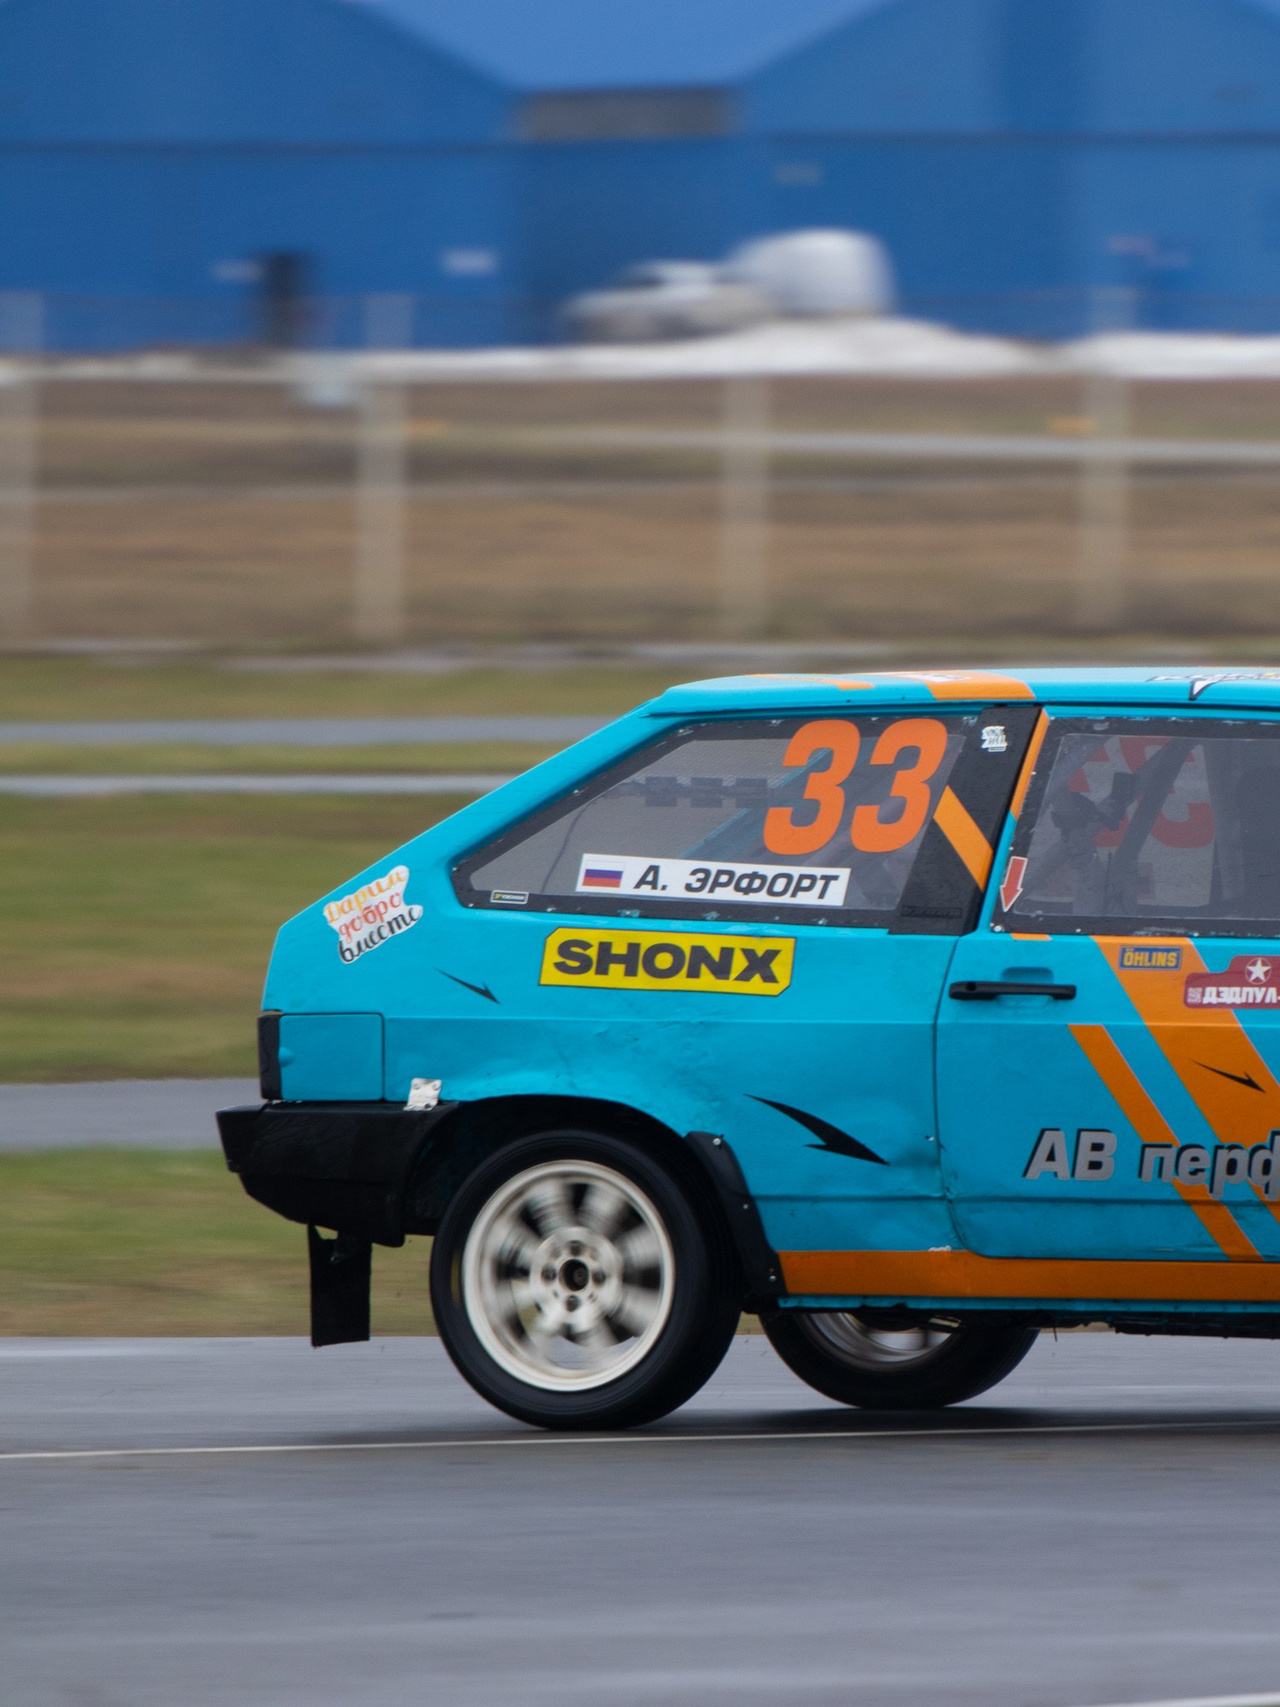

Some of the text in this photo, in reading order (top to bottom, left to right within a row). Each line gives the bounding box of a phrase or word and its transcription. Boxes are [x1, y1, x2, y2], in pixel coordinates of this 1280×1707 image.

[763, 718, 948, 855] 33
[634, 865, 840, 900] А. ЭРФОРТ
[553, 938, 782, 984] SHONX
[1123, 947, 1177, 967] ÖHLINS
[1022, 1128, 1118, 1181] АВ
